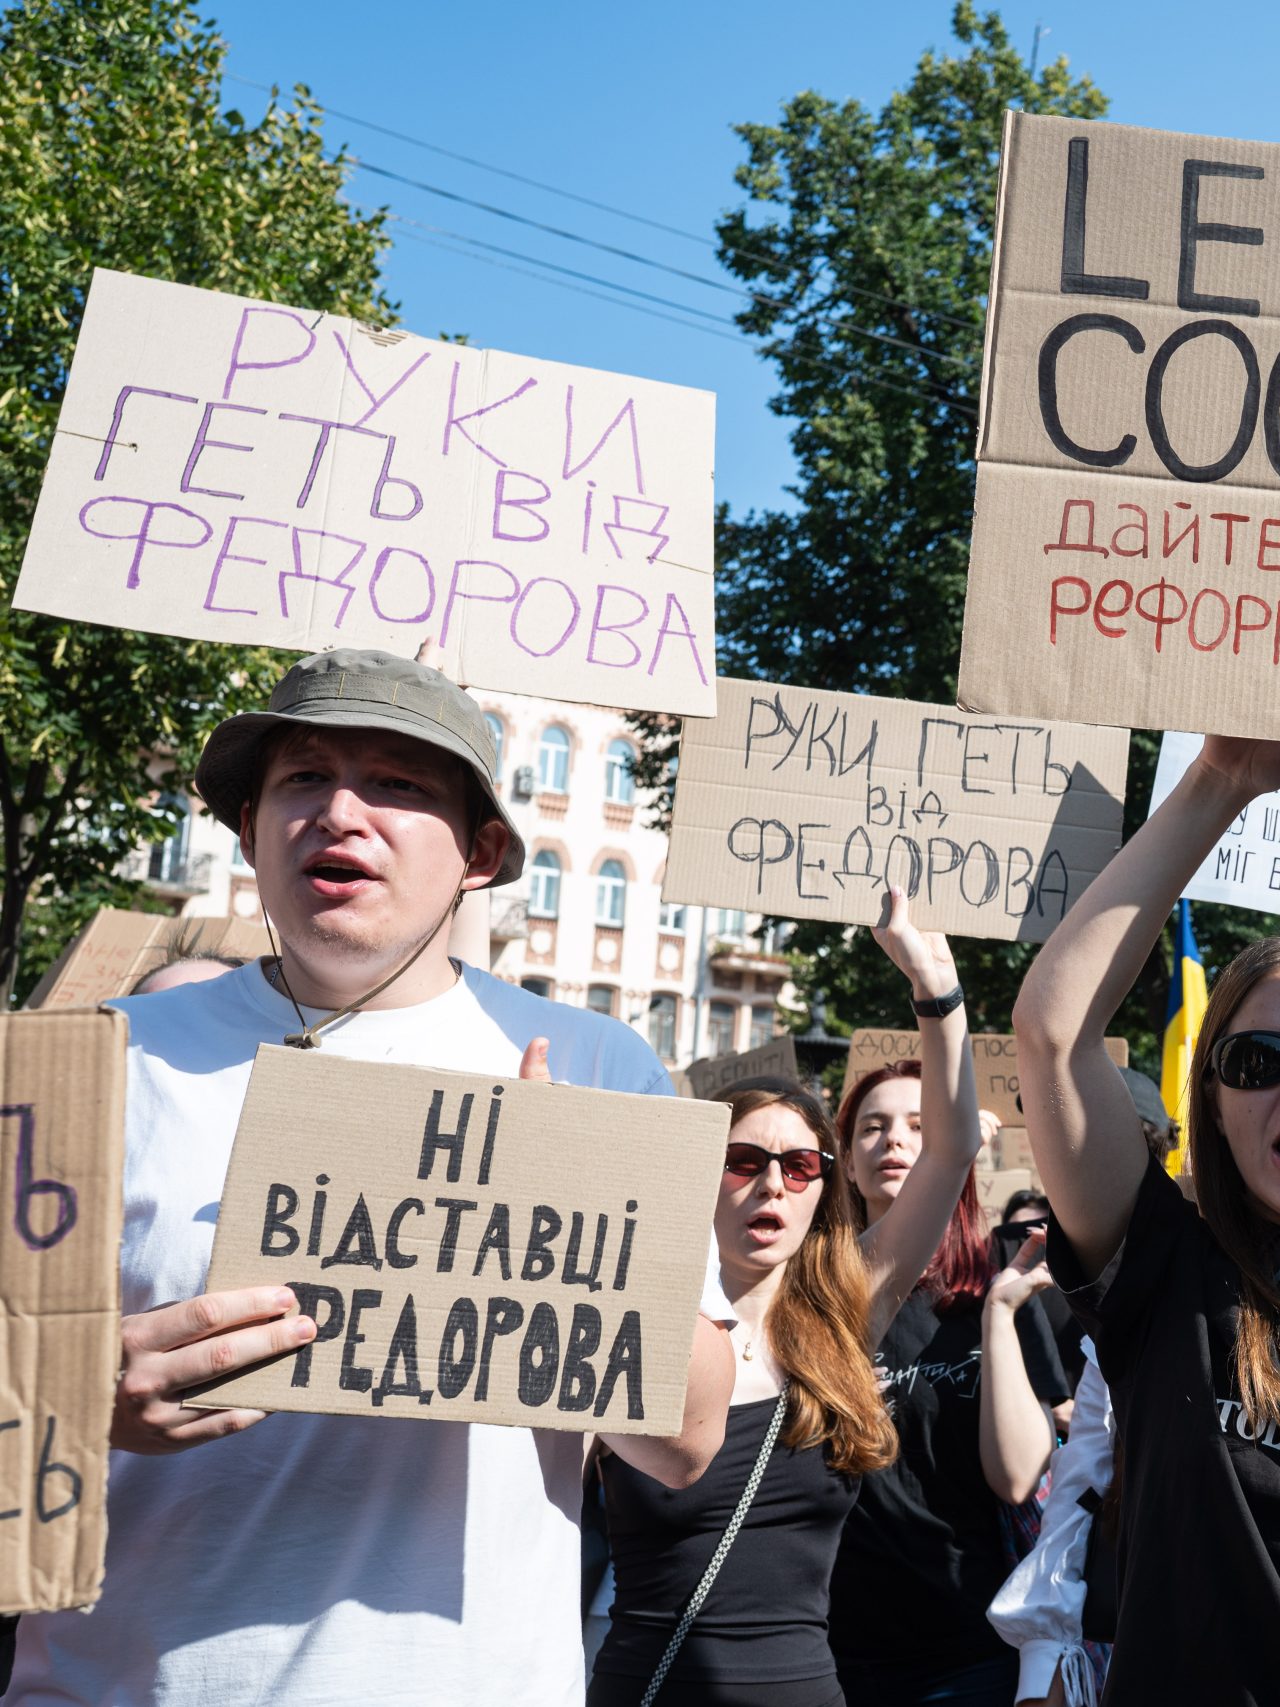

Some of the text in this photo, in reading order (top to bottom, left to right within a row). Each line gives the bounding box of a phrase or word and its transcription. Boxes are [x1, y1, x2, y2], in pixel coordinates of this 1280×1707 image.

[223, 308, 646, 494] РУКИ
[93, 385, 670, 563] ГЕТЬ ВІД
[79, 496, 709, 687] ФЕДОРОВА
[744, 692, 1073, 796] РУКИ ГЕТЬ
[728, 816, 1069, 921] ФЕДОРОВА
[416, 1084, 506, 1186] НІ
[260, 1172, 639, 1292] ВІДСТАВЦІ
